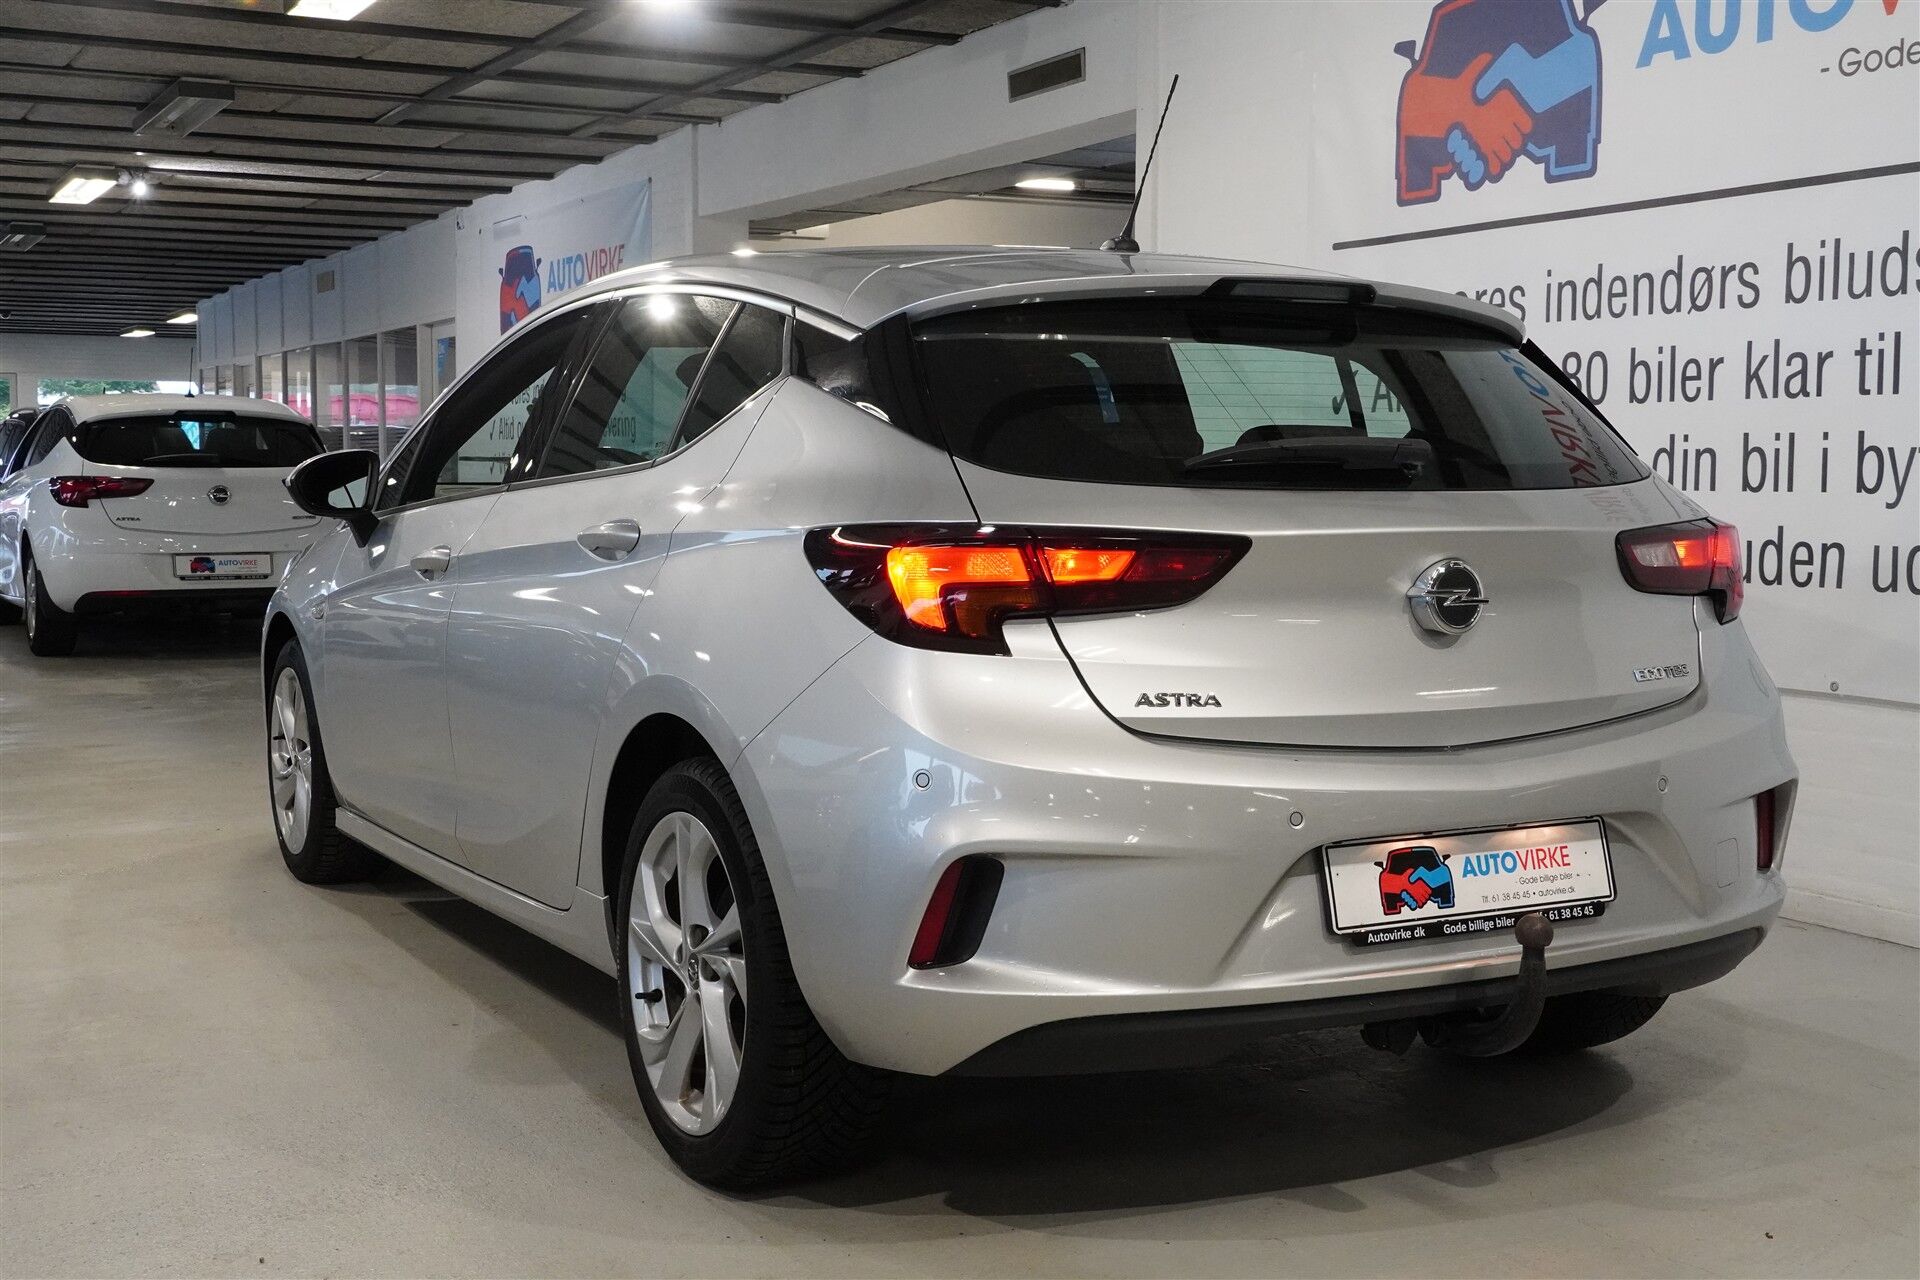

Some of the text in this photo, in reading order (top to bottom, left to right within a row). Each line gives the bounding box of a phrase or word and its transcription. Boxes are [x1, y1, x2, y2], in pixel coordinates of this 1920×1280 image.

[1545, 255, 1761, 323] indendørs
[1561, 331, 1902, 406] 80 biler klar til
[1652, 433, 1716, 492] din
[1741, 432, 1795, 493] bil
[1821, 431, 1829, 493] i
[1856, 430, 1920, 510] by
[1633, 663, 1690, 682] ECOTEC
[1134, 692, 1222, 708] ASTRA
[1462, 846, 1571, 878] AUTOVIRKE
[1491, 894, 1500, 903] 61
[1502, 892, 1511, 902] 38
[1512, 891, 1521, 900] 45
[1522, 890, 1531, 899] 45
[1519, 876, 1538, 885] Gode
[1367, 928, 1412, 944] Autovirke
[1413, 926, 1426, 938] dk
[1443, 922, 1467, 935] Gode
[1468, 919, 1494, 932] billige
[1495, 916, 1516, 928] biler
[1549, 911, 1559, 921] 61
[1560, 908, 1571, 919] 38
[1572, 907, 1583, 918] 45
[1583, 905, 1594, 916] 45
